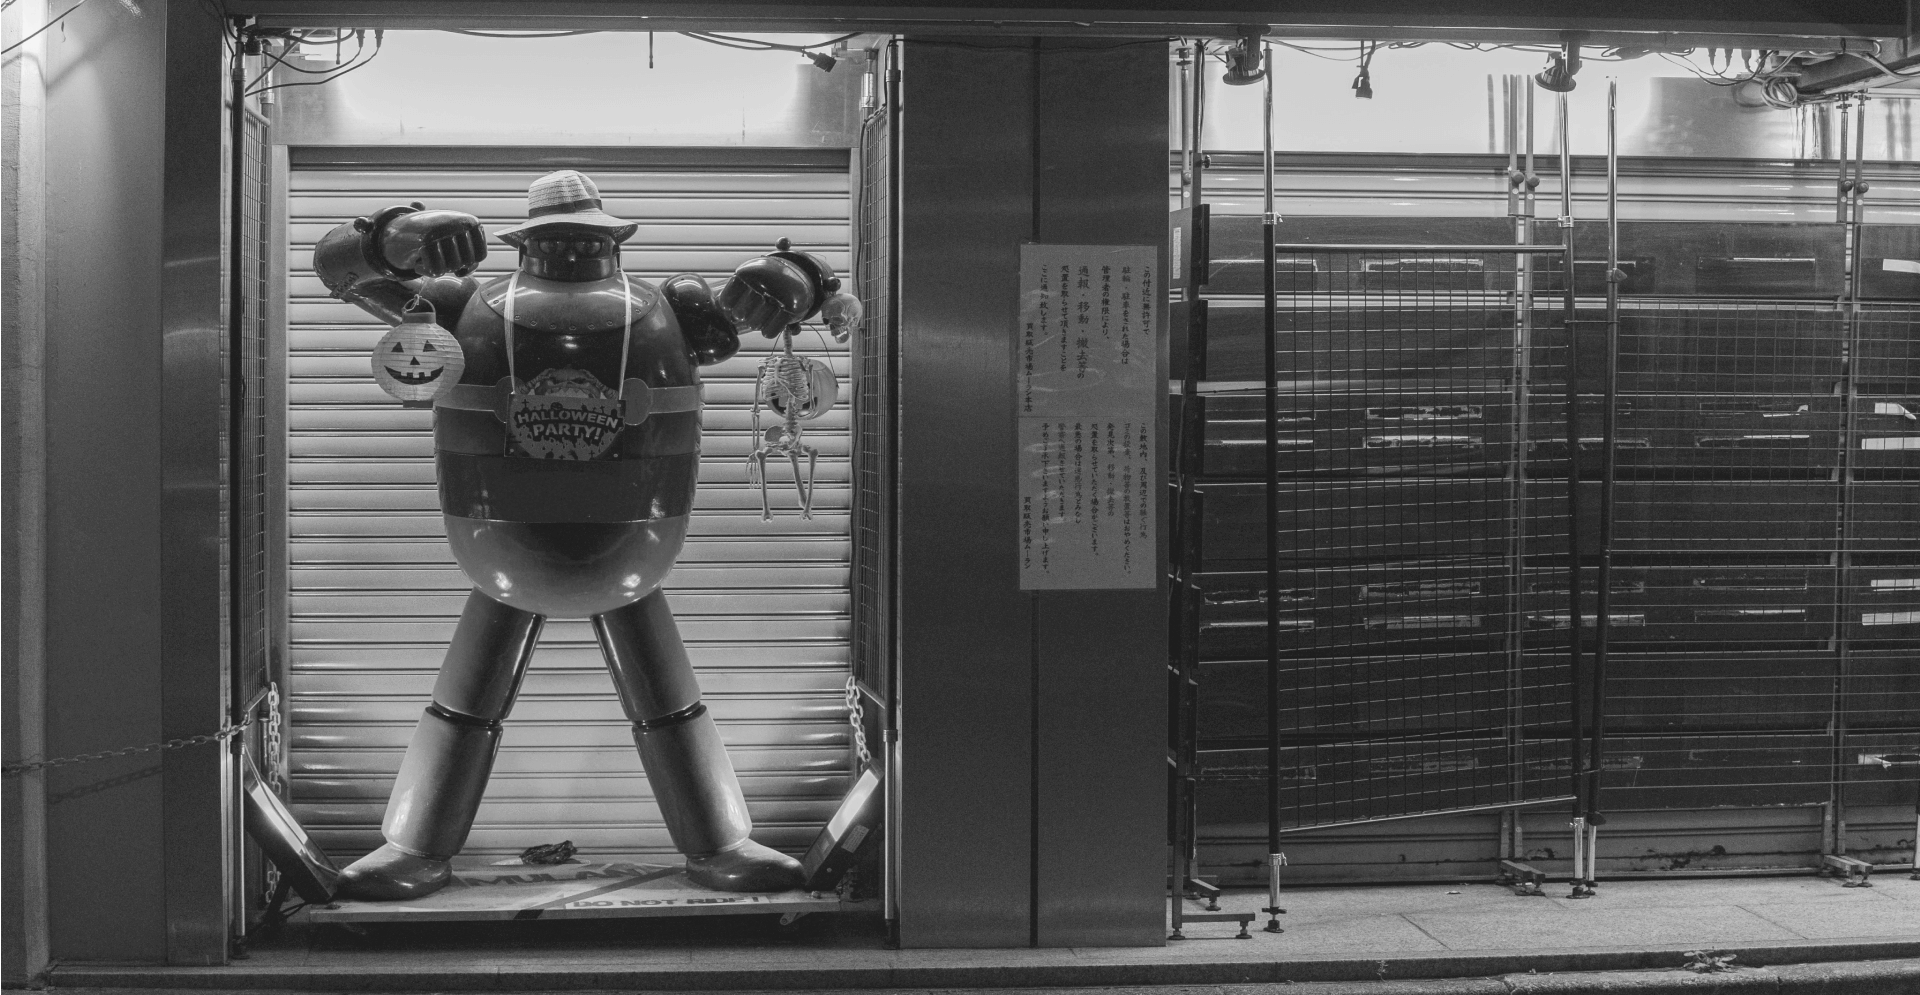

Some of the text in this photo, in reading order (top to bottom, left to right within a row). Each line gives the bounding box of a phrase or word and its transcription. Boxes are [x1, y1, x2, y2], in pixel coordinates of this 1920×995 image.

[1142, 265, 1152, 336] この付近に無許可で
[517, 410, 619, 429] HALLOWEEN
[532, 423, 602, 440] PARTY!
[573, 900, 613, 908] DO
[620, 897, 678, 907] NOT
